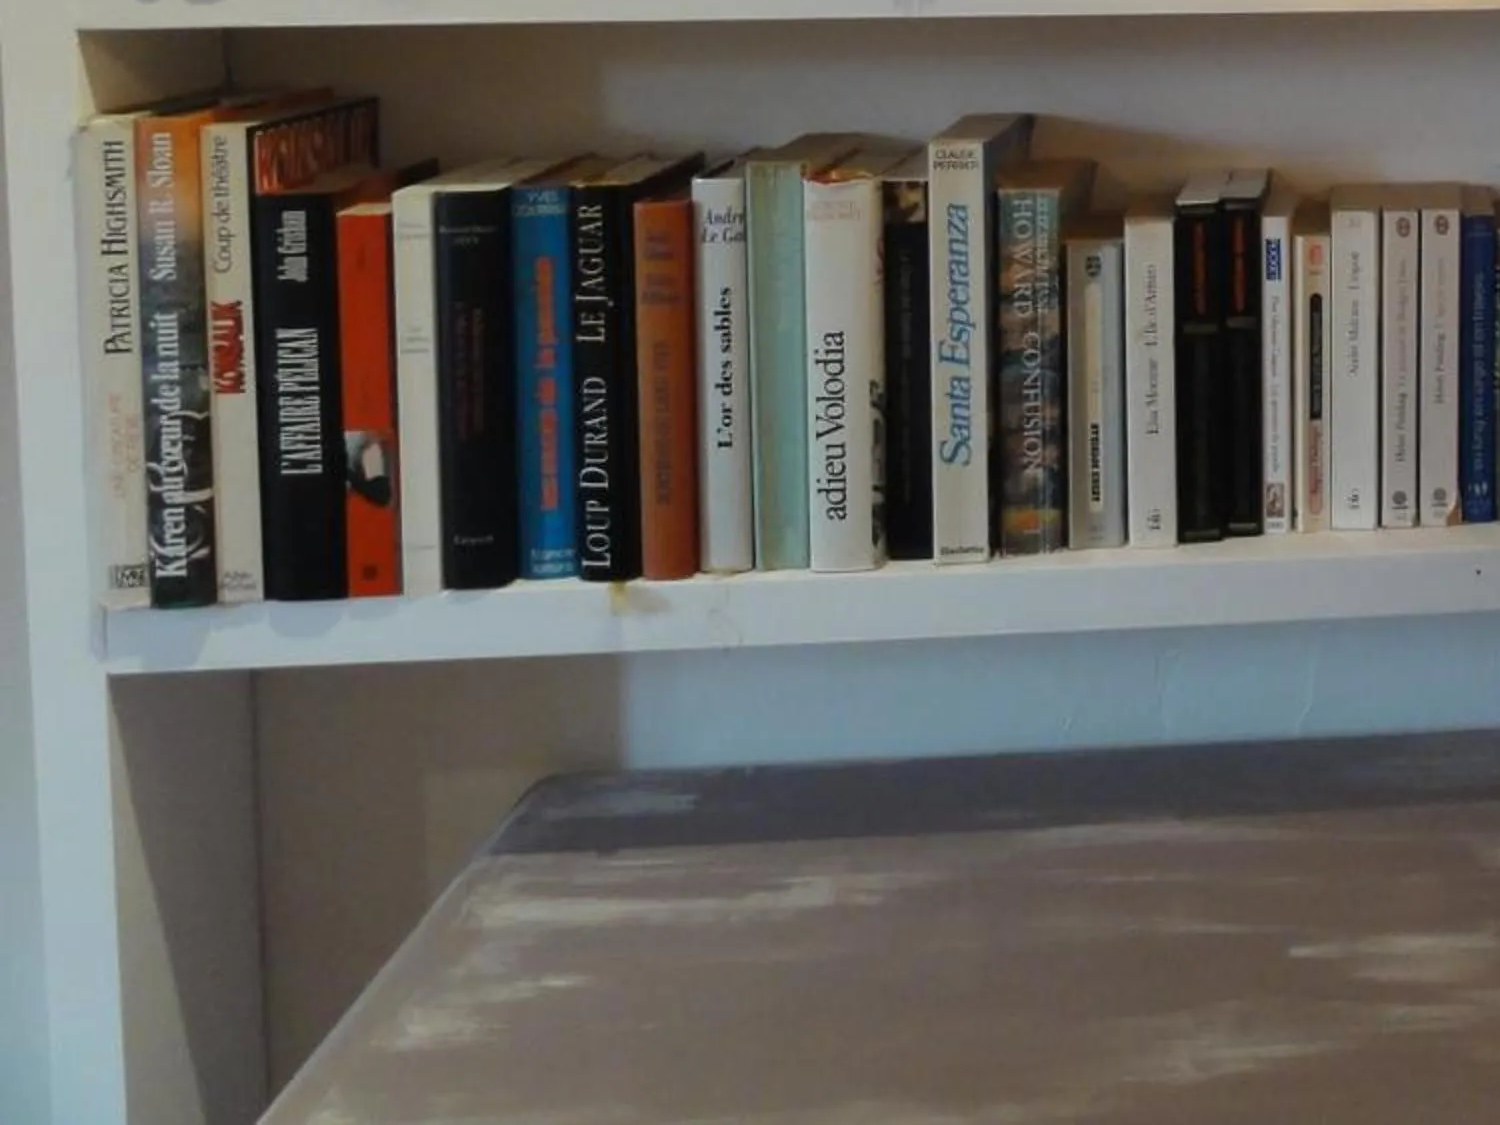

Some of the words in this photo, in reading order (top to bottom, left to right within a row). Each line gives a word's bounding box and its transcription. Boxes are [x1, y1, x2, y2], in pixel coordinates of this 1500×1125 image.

[146, 132, 175, 188] Sloan
[208, 136, 229, 198] théâtre
[101, 140, 129, 257] HIGHSMITH
[212, 201, 231, 219] de
[150, 221, 177, 281] Susan
[212, 226, 233, 274] Coup
[576, 204, 615, 303] JAGUAR
[1009, 197, 1032, 318] HOWARD
[105, 263, 134, 355] PATRICIA
[936, 202, 976, 366] Esperanza
[150, 311, 178, 357] nuit
[576, 312, 605, 343] LE
[714, 287, 732, 354] sables
[152, 361, 178, 381] la
[274, 327, 321, 392] PÉLICAN
[716, 360, 733, 397] des
[814, 330, 846, 441] Volodia
[150, 385, 180, 411] de
[716, 402, 734, 449] L'or
[938, 376, 972, 467] Santa
[1020, 332, 1042, 476] CONFUSION
[280, 396, 323, 475] L'AFFAIRE
[578, 376, 610, 489] DURAND
[817, 444, 848, 521] adieu
[153, 508, 189, 578] Karen
[580, 500, 612, 567] LOUP
